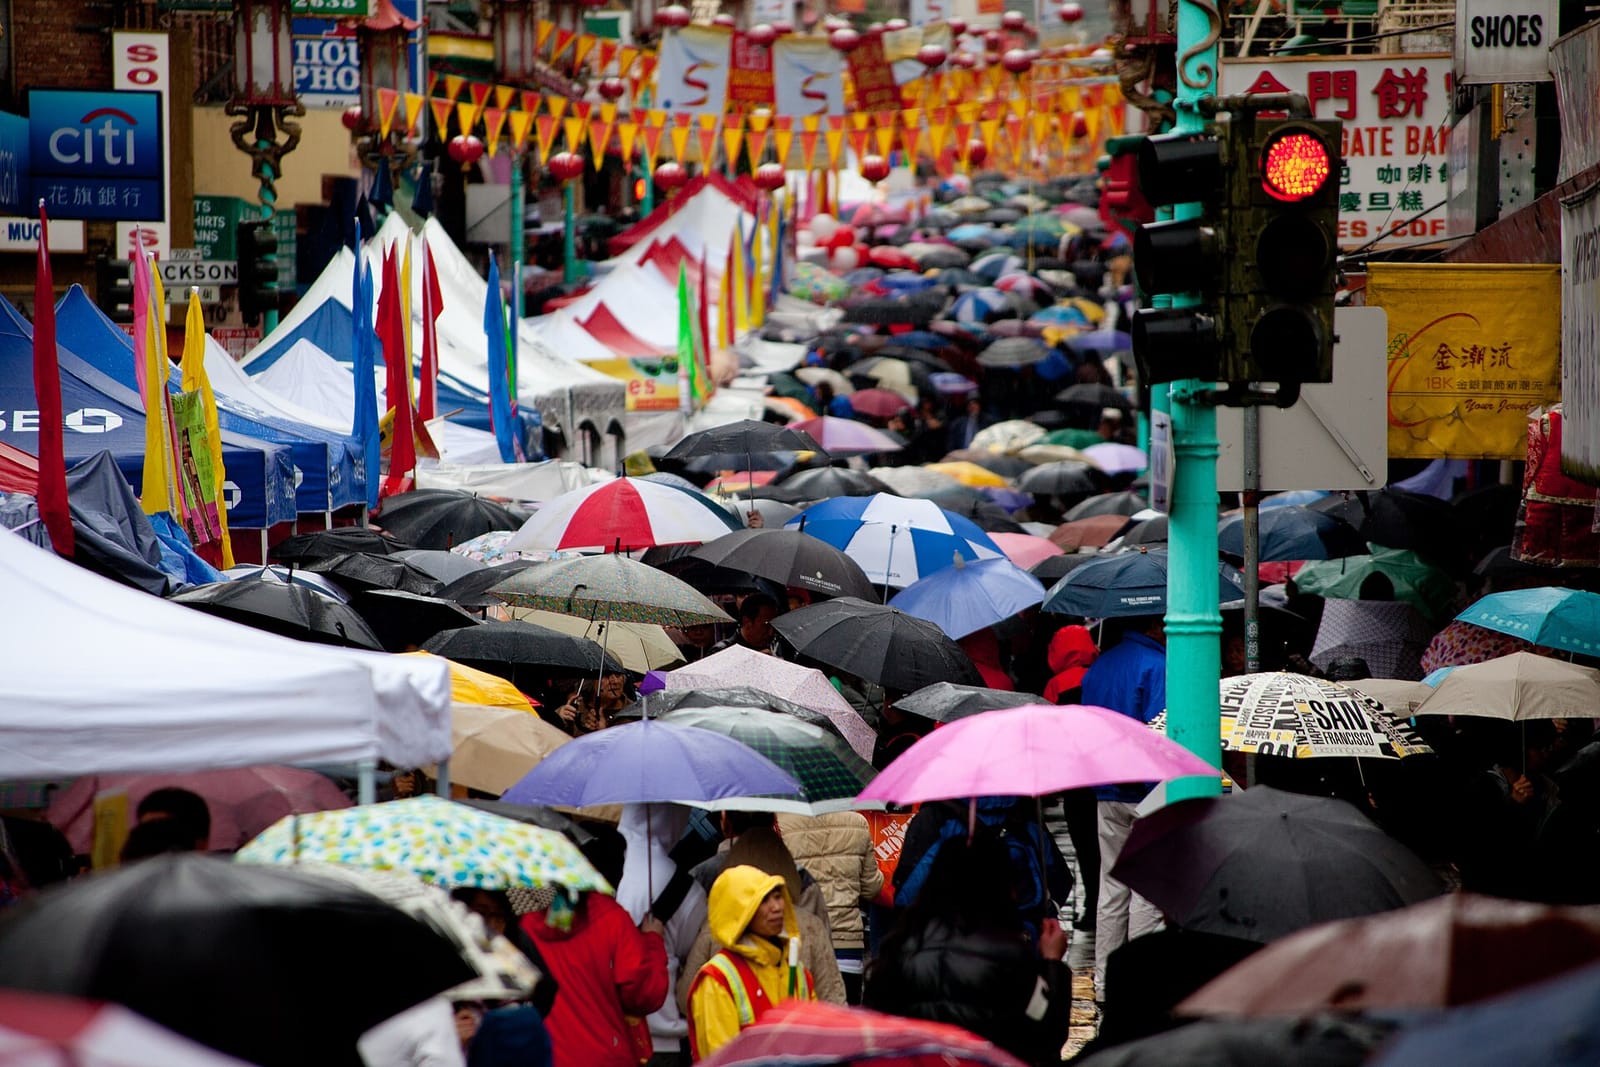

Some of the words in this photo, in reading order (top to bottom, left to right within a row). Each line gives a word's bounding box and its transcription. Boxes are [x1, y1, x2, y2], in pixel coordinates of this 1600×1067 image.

[1470, 14, 1543, 48] SHOES
[293, 65, 360, 91] PHO
[49, 120, 136, 165] citi
[48, 185, 142, 208] 花旗銀行
[160, 264, 238, 280] CKSON
[1432, 341, 1519, 371] 金潮流
[1464, 398, 1495, 412] Your
[1301, 711, 1326, 745] HAPPEN
[1308, 700, 1369, 731] SAN
[1245, 729, 1271, 740] HAPPEN
[1322, 731, 1375, 746] FRANCISCO
[874, 814, 916, 860] HOM
[880, 819, 900, 836] THE
